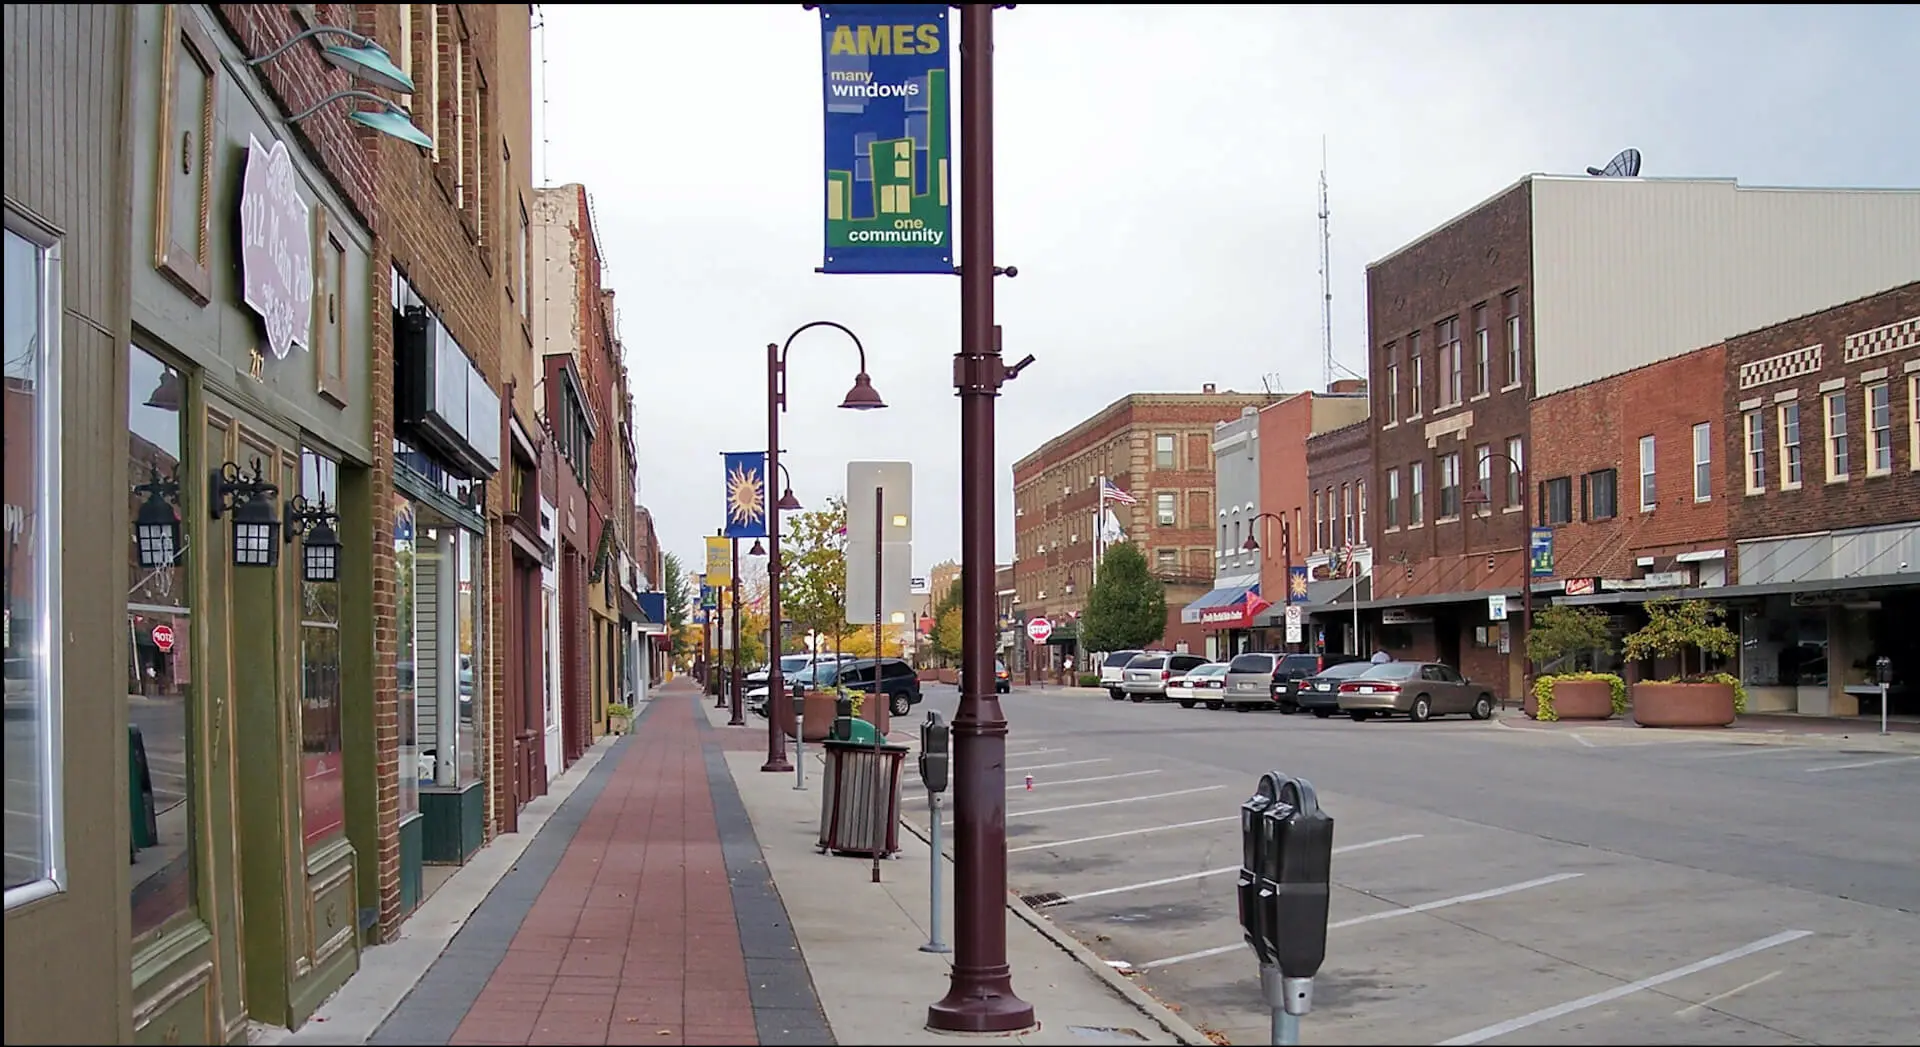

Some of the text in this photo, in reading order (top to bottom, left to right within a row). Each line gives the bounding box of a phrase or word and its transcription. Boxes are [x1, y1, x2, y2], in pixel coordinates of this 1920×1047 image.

[830, 23, 940, 56] AMES
[831, 70, 873, 84] many
[832, 82, 919, 97] windows
[245, 192, 265, 249] 212
[894, 217, 923, 229] one
[849, 228, 943, 245] community
[1030, 624, 1049, 635] STOP
